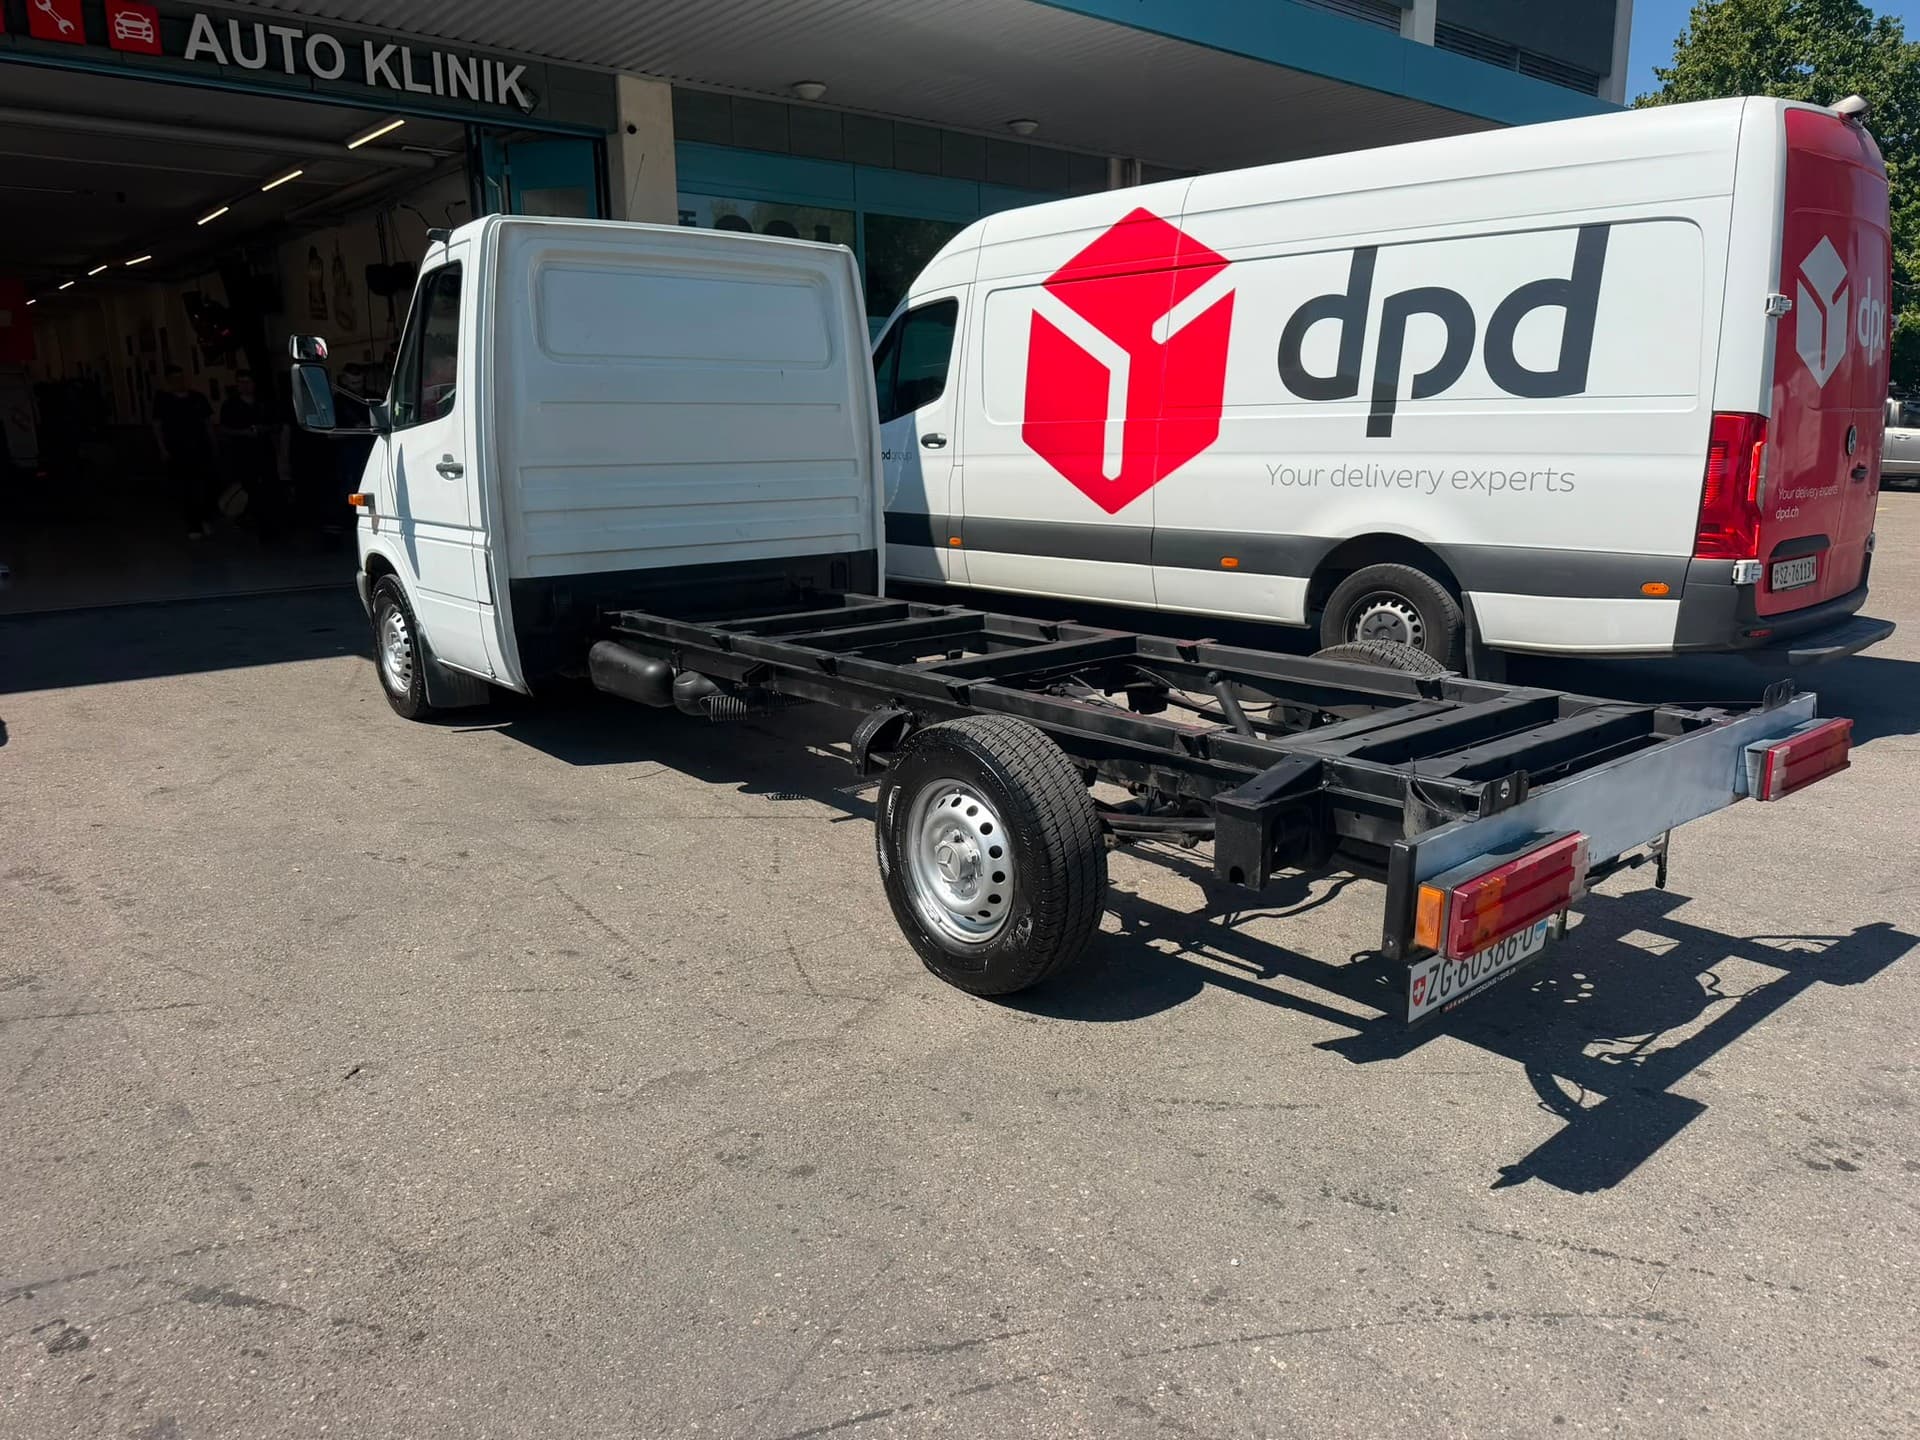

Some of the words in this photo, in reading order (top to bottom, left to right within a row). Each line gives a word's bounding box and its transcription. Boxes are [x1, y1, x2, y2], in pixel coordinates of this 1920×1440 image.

[184, 13, 346, 80] AUTO
[364, 39, 530, 108] KLINIK
[1278, 223, 1610, 437] dpd
[1266, 463, 1326, 487] Your
[1330, 463, 1445, 495] delivery
[1451, 467, 1576, 497] experts
[1778, 487, 1795, 500] Your
[1775, 505, 1800, 521] dpd.ch
